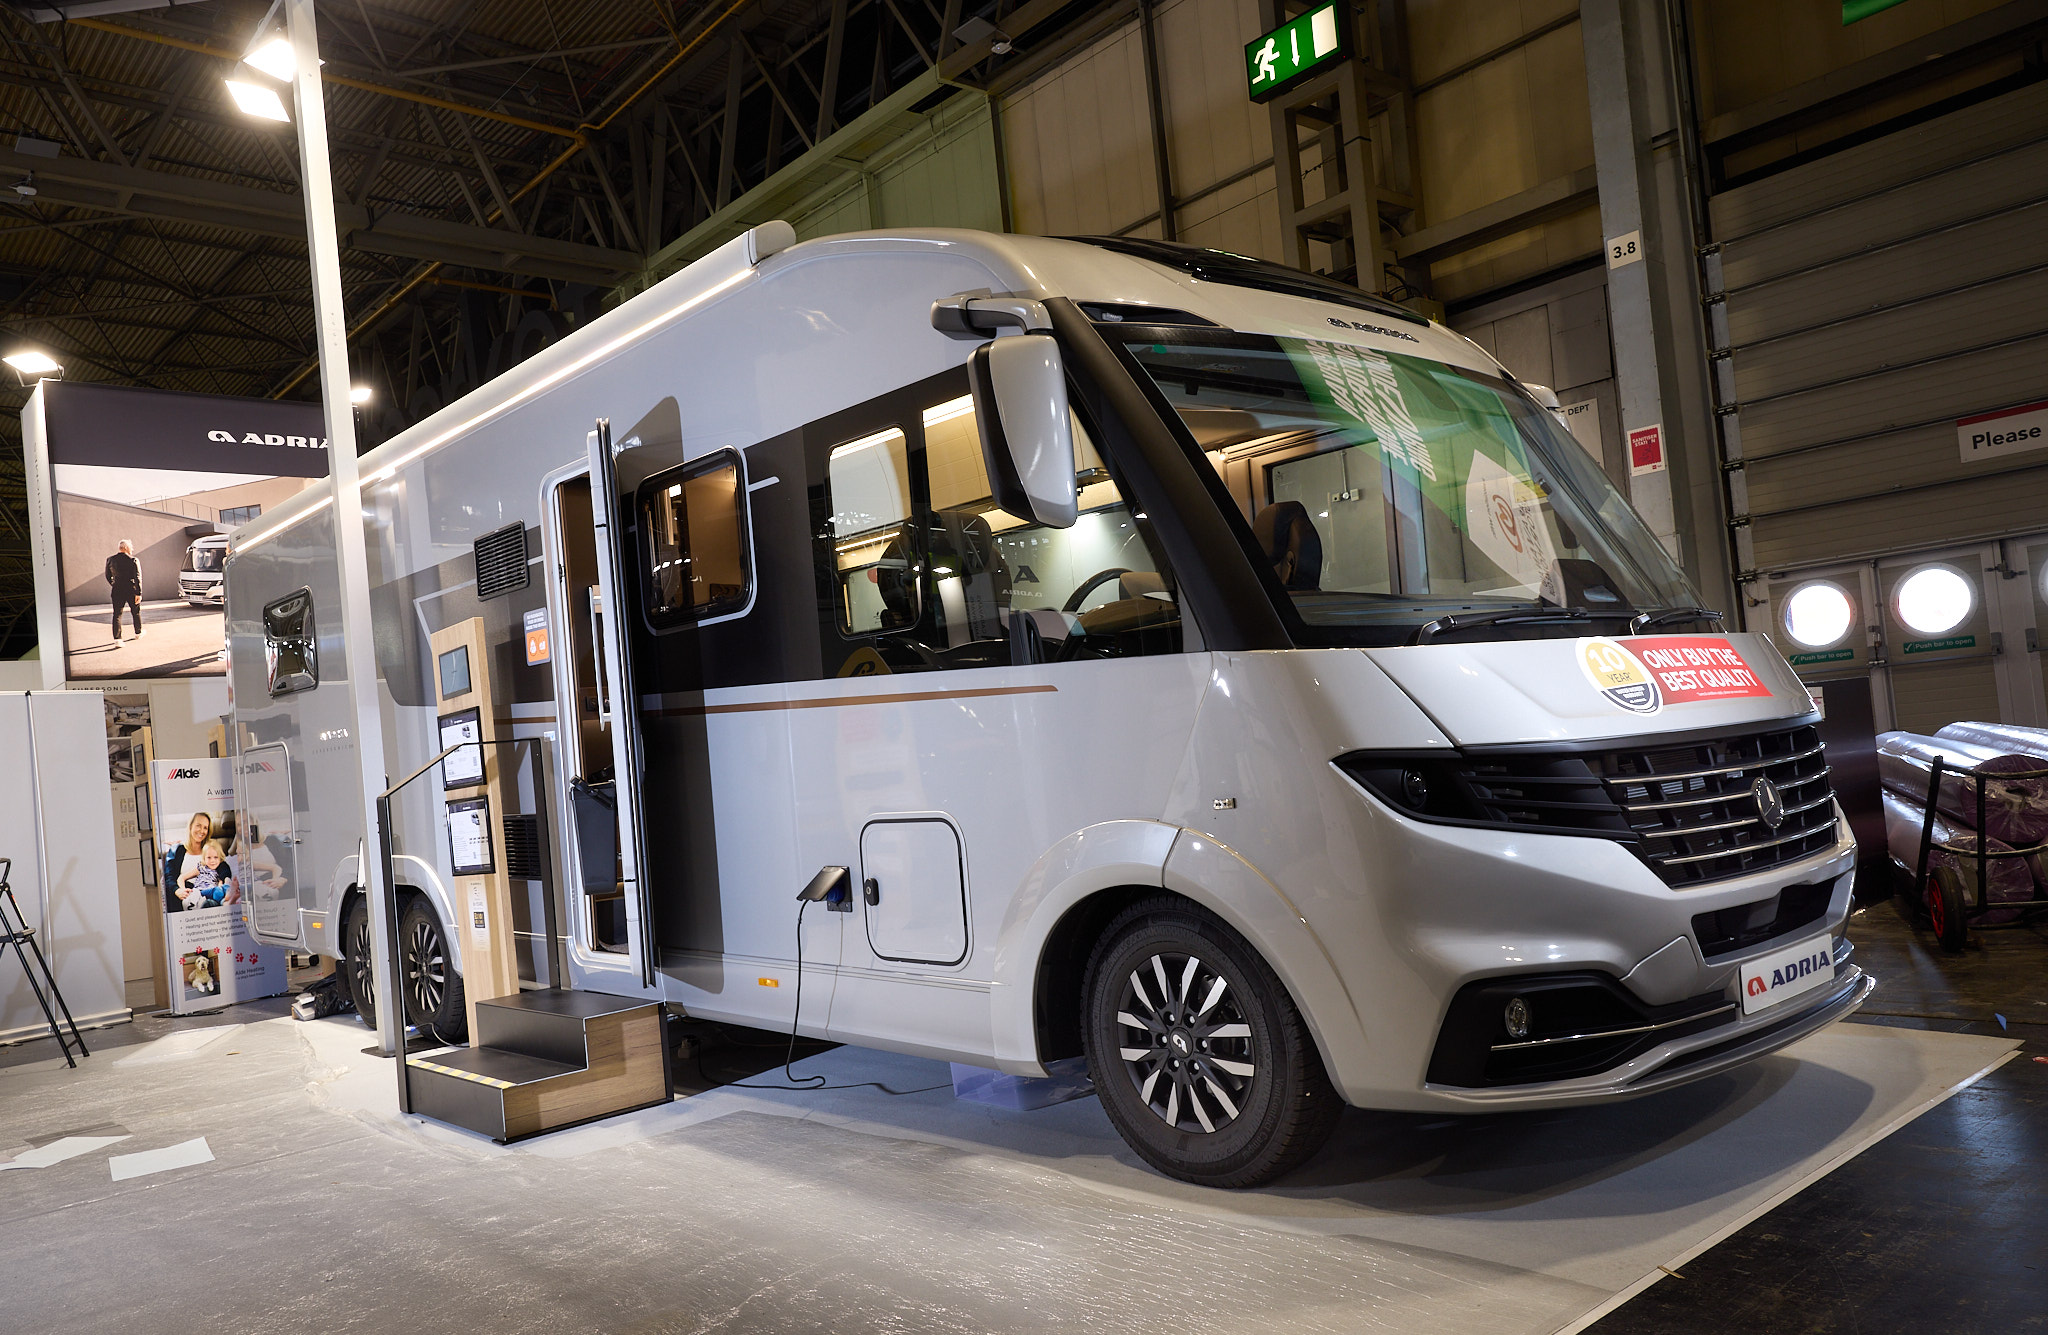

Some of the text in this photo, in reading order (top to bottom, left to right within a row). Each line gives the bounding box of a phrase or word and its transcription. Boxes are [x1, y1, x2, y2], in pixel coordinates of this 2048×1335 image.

[1613, 241, 1636, 259] 3.8
[1567, 403, 1590, 416] DEPT
[1632, 433, 1657, 444] SANITISER
[1634, 439, 1656, 448] STATIN
[1972, 426, 2042, 450] Please
[1955, 638, 1972, 646] open
[1588, 647, 1626, 673] 10
[1643, 648, 1743, 669] ONLY BUY THE
[1836, 651, 1851, 659] open
[1659, 668, 1758, 692] BEST QUALITY
[174, 768, 200, 779] Alde
[207, 787, 234, 796] A warm
[1771, 950, 1831, 989] ADRIA
